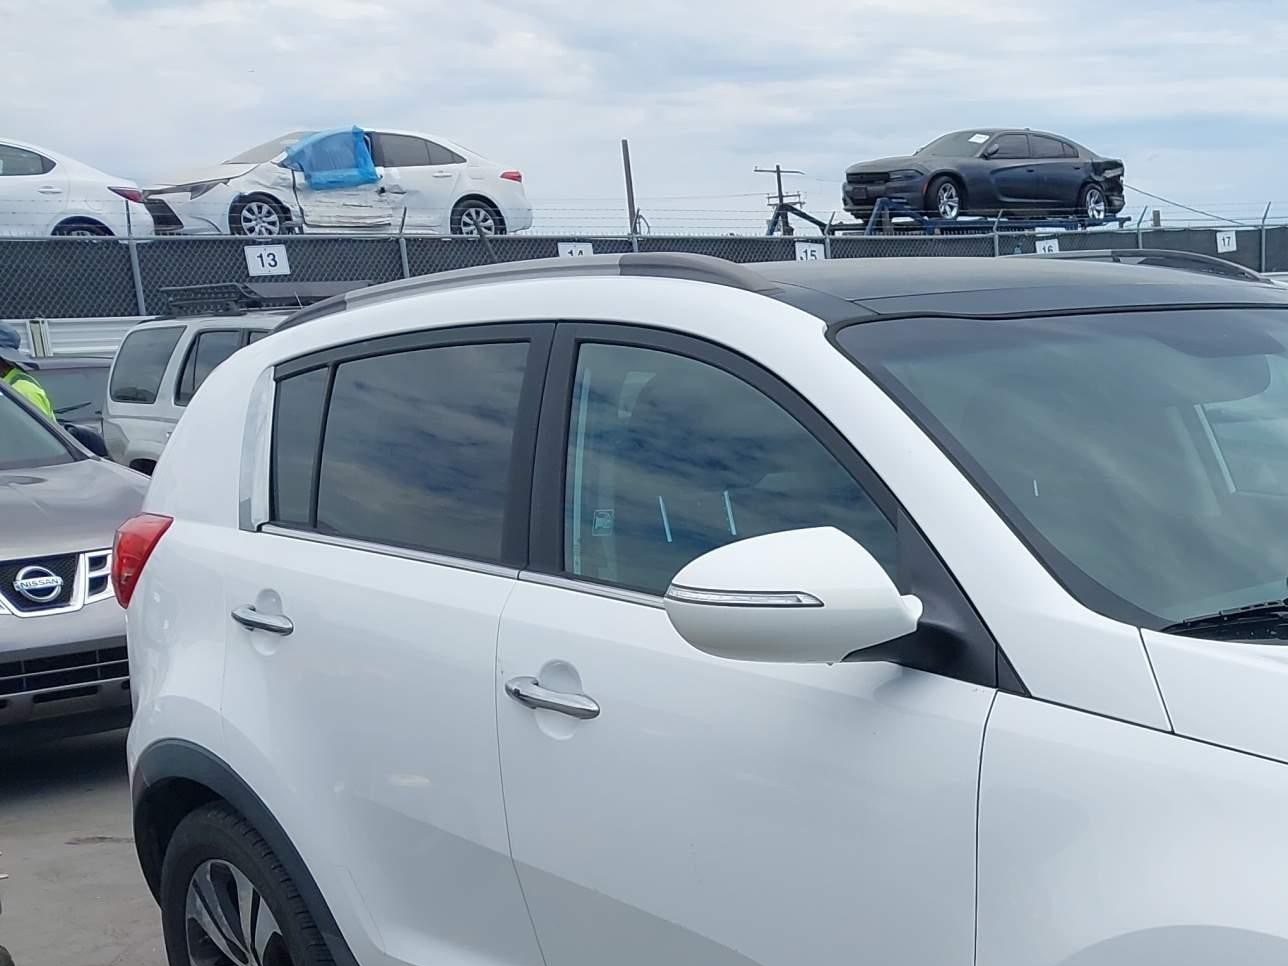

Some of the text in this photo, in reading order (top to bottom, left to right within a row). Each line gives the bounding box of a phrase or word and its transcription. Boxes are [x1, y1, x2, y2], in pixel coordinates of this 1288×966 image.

[1221, 236, 1231, 247] 17
[256, 252, 278, 268] 13
[802, 249, 817, 261] 15
[20, 578, 59, 588] NISSAN
